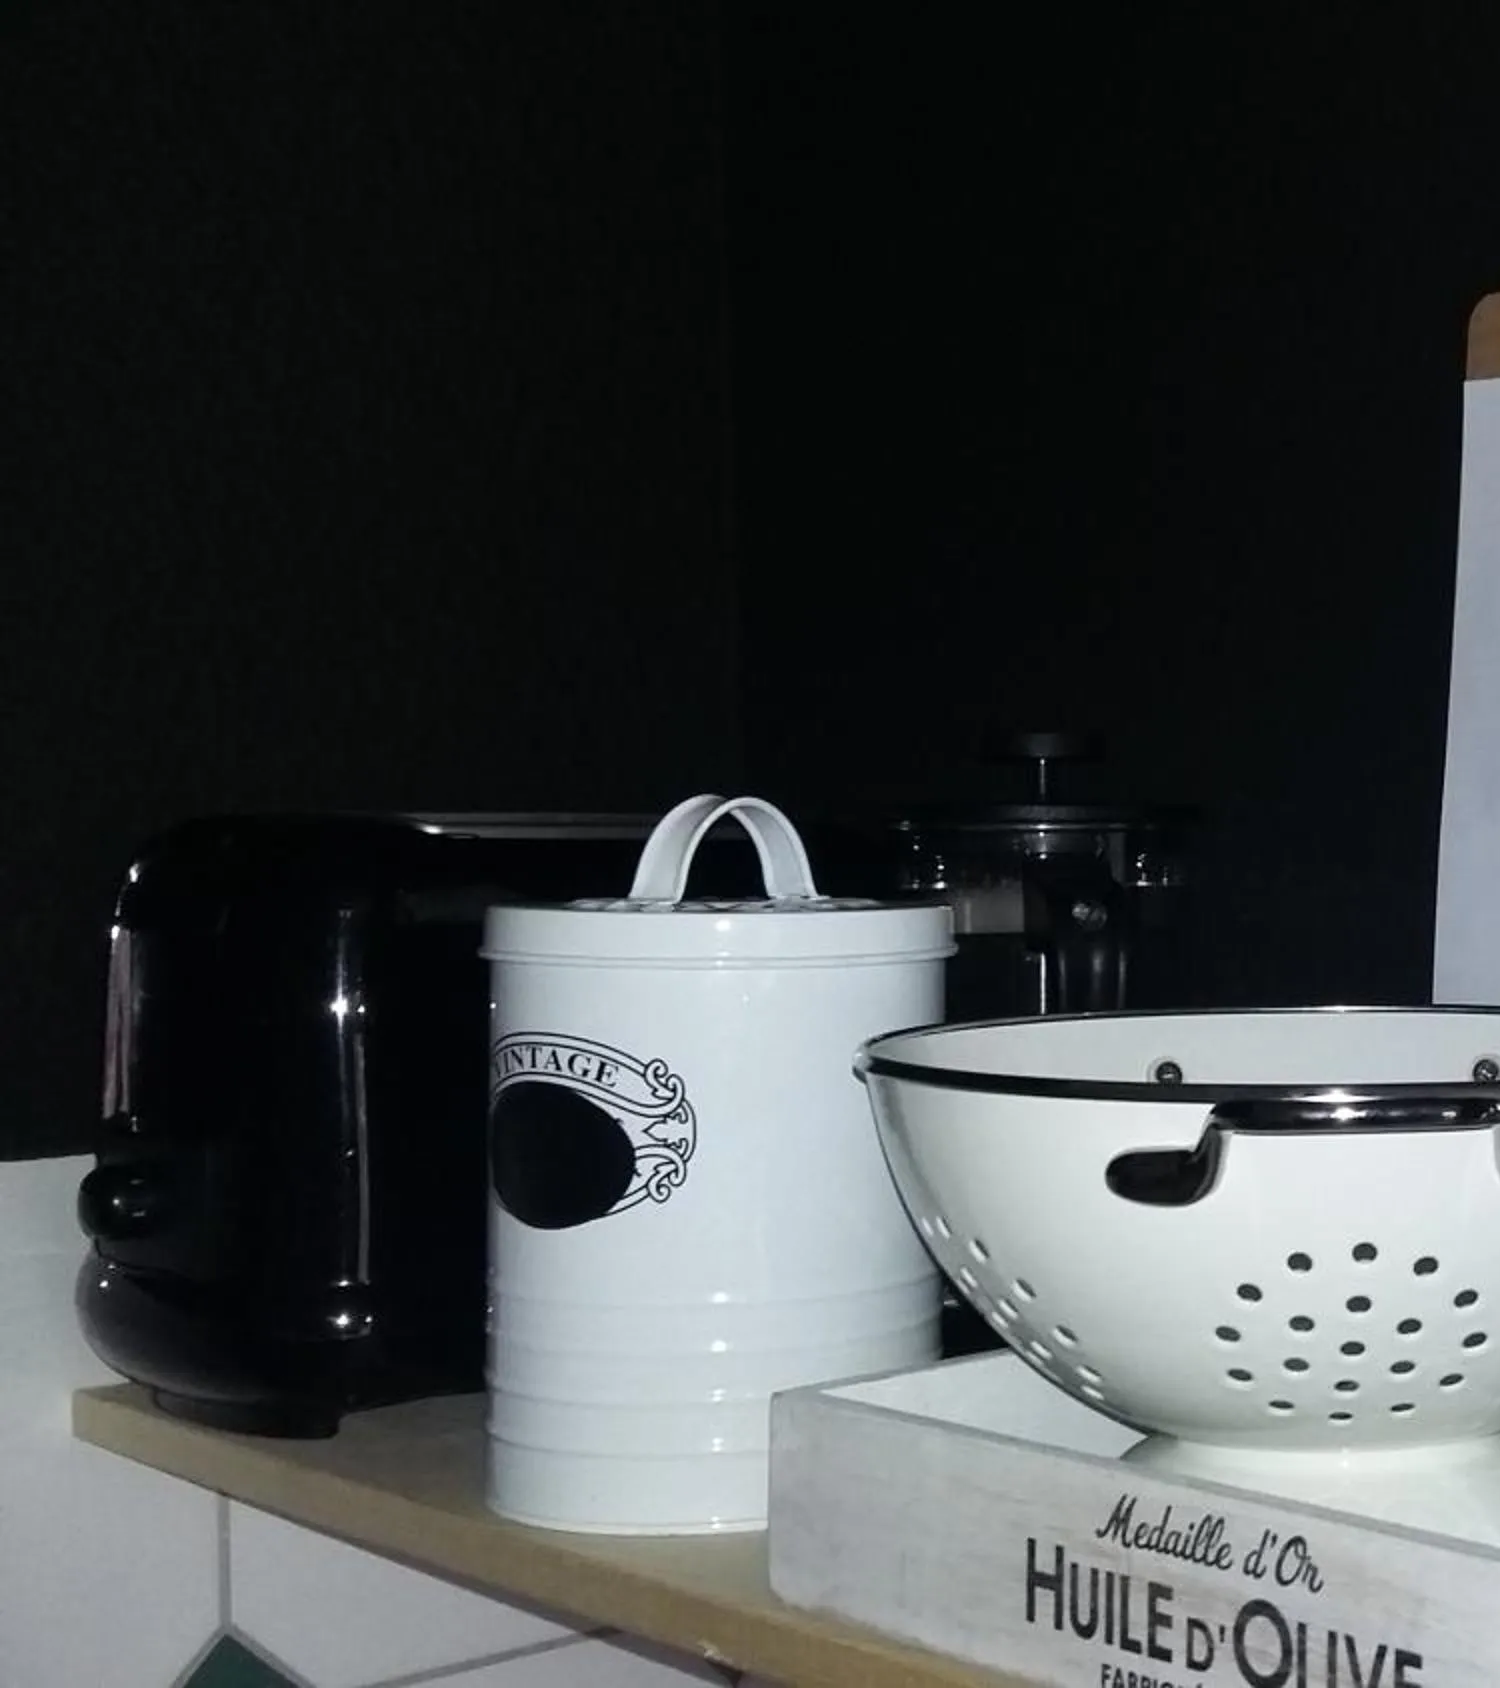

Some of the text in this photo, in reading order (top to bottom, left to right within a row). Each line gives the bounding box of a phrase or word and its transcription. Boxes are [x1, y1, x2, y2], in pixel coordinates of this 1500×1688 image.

[1025, 1536, 1174, 1664] HUILE
[1095, 1493, 1325, 1594] Medaille d'Or
